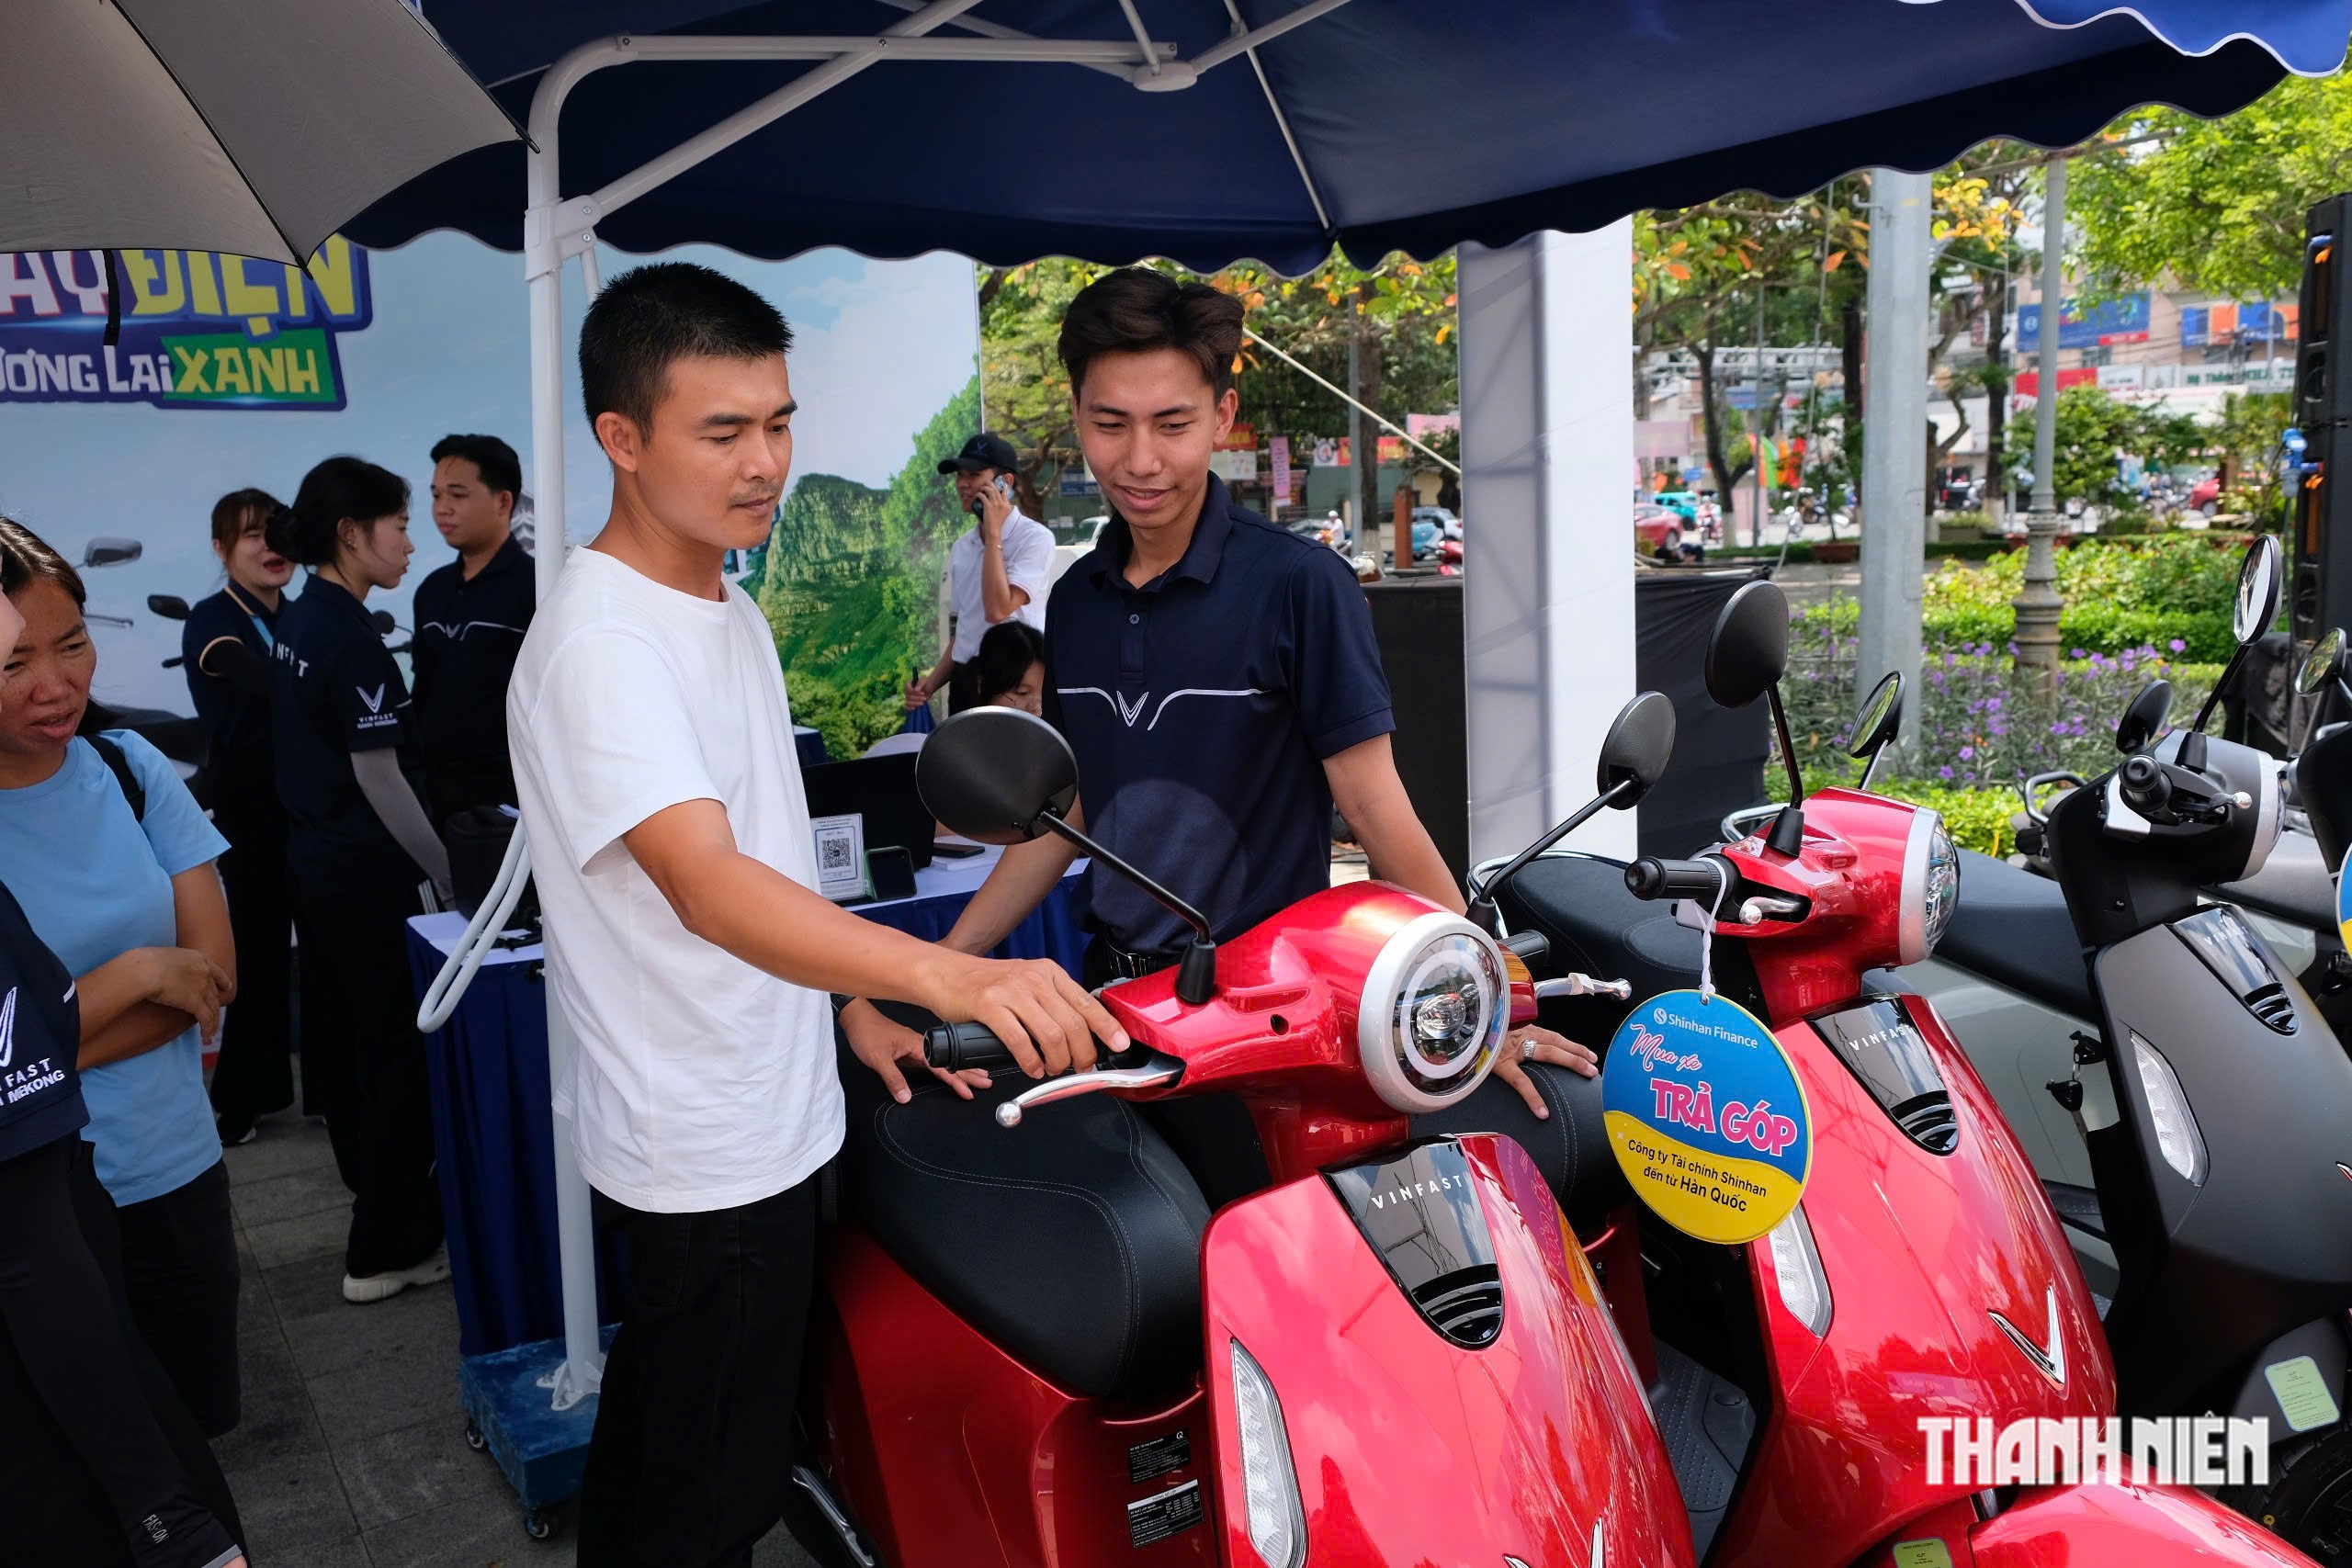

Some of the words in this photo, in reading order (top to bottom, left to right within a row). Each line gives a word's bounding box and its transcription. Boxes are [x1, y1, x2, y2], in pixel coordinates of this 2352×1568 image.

[0, 346, 100, 392] ƠNG
[173, 346, 320, 394] XANH
[1630, 1023, 1679, 1071] Mua
[1676, 1054, 1702, 1071] xe
[1668, 1013, 1712, 1036] Shinhan
[1713, 1025, 1758, 1048] Finance
[0, 1057, 51, 1091] FAST
[7, 1069, 65, 1103] MEKONG
[1650, 1077, 1717, 1134] TRẢ
[1720, 1100, 1798, 1156] GÓP
[1628, 1139, 1656, 1160] Công
[1657, 1150, 1668, 1165] ty
[1671, 1154, 1686, 1169] Tài
[1689, 1162, 1718, 1180] chính
[1721, 1171, 1767, 1197] Shinhan
[1644, 1166, 1663, 1181] đến
[1666, 1174, 1678, 1186] từ
[1679, 1176, 1706, 1198] Hàn
[1710, 1187, 1747, 1212] Quốc
[1371, 1175, 1463, 1209] VINFAST
